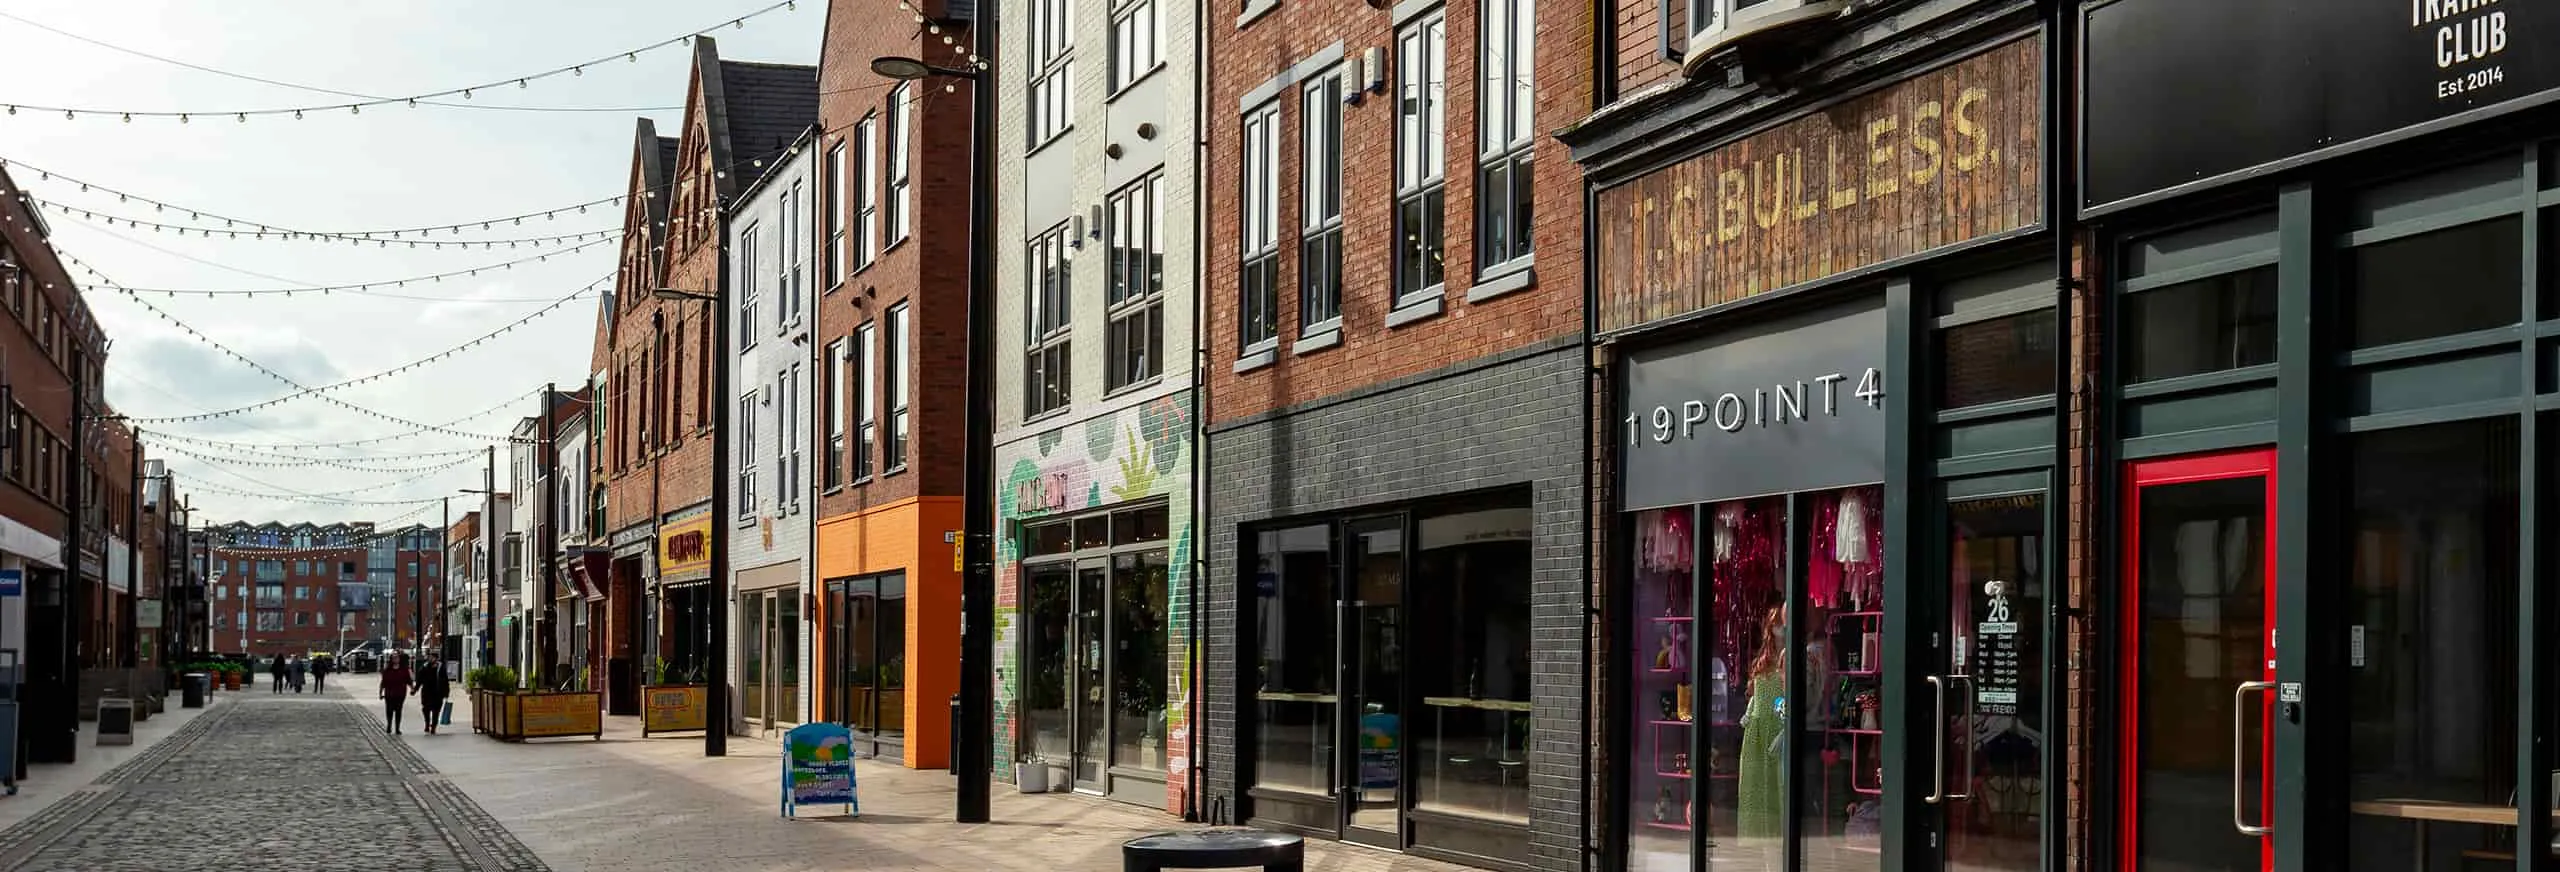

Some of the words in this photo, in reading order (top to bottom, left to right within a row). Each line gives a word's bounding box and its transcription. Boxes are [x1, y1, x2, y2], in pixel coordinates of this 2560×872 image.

[2437, 11, 2506, 68] CLUB
[2438, 77, 2464, 98] Est
[2467, 65, 2504, 91] 2014
[1987, 597, 2009, 622] 26
